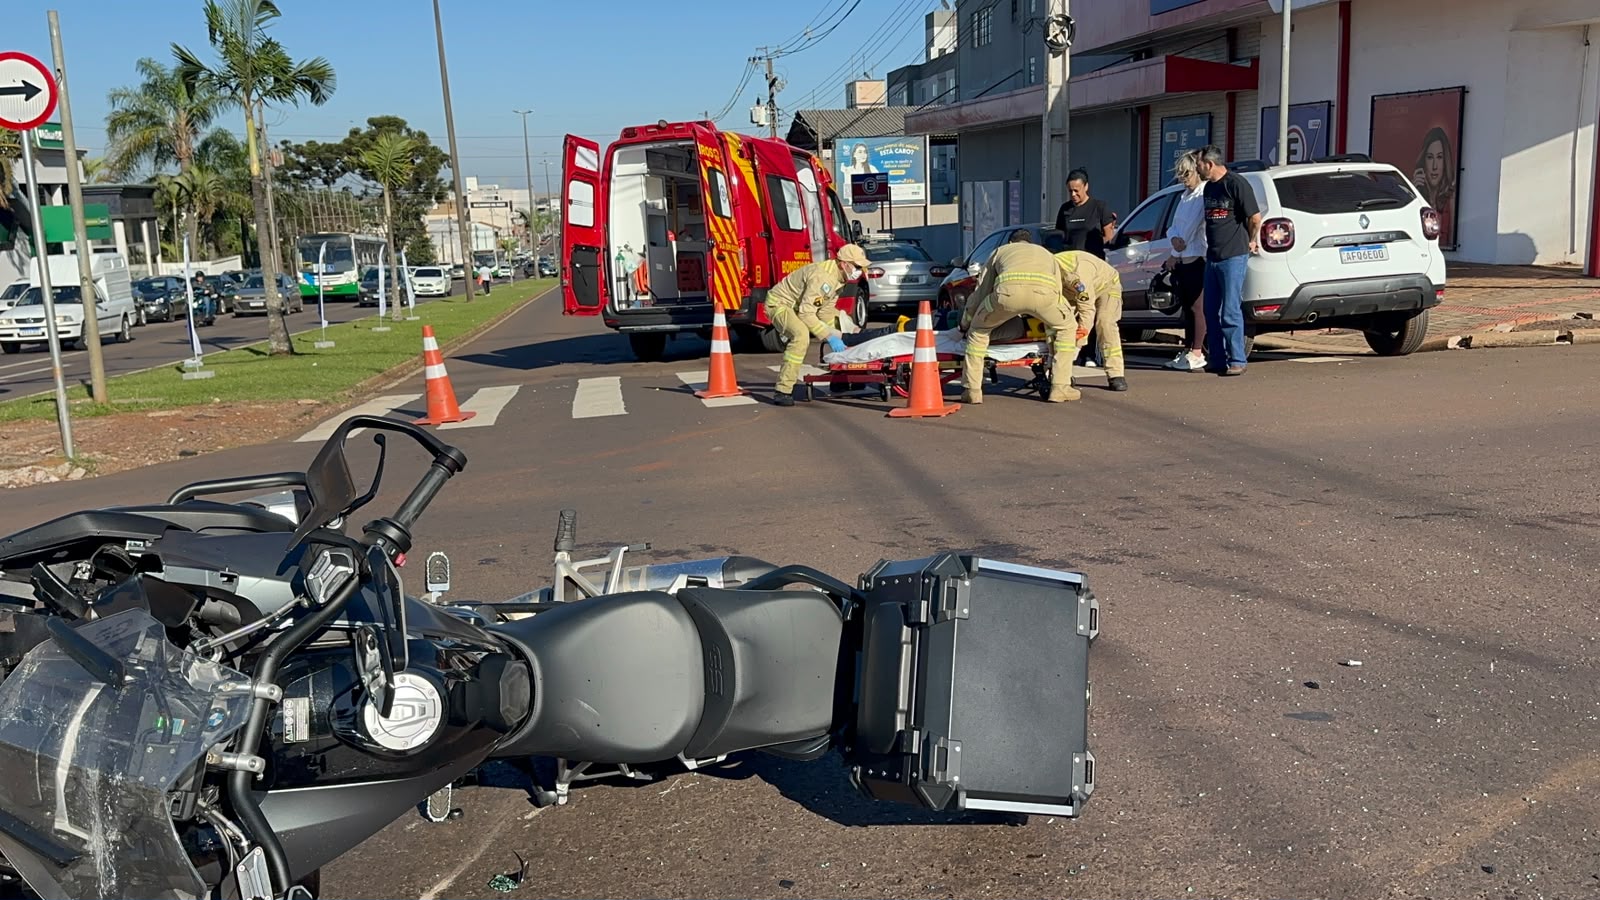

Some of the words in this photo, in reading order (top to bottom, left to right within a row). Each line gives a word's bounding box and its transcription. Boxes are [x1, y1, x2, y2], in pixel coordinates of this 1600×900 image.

[894, 148, 915, 156] CARO?
[1287, 138, 1299, 164] E
[867, 181, 875, 191] E
